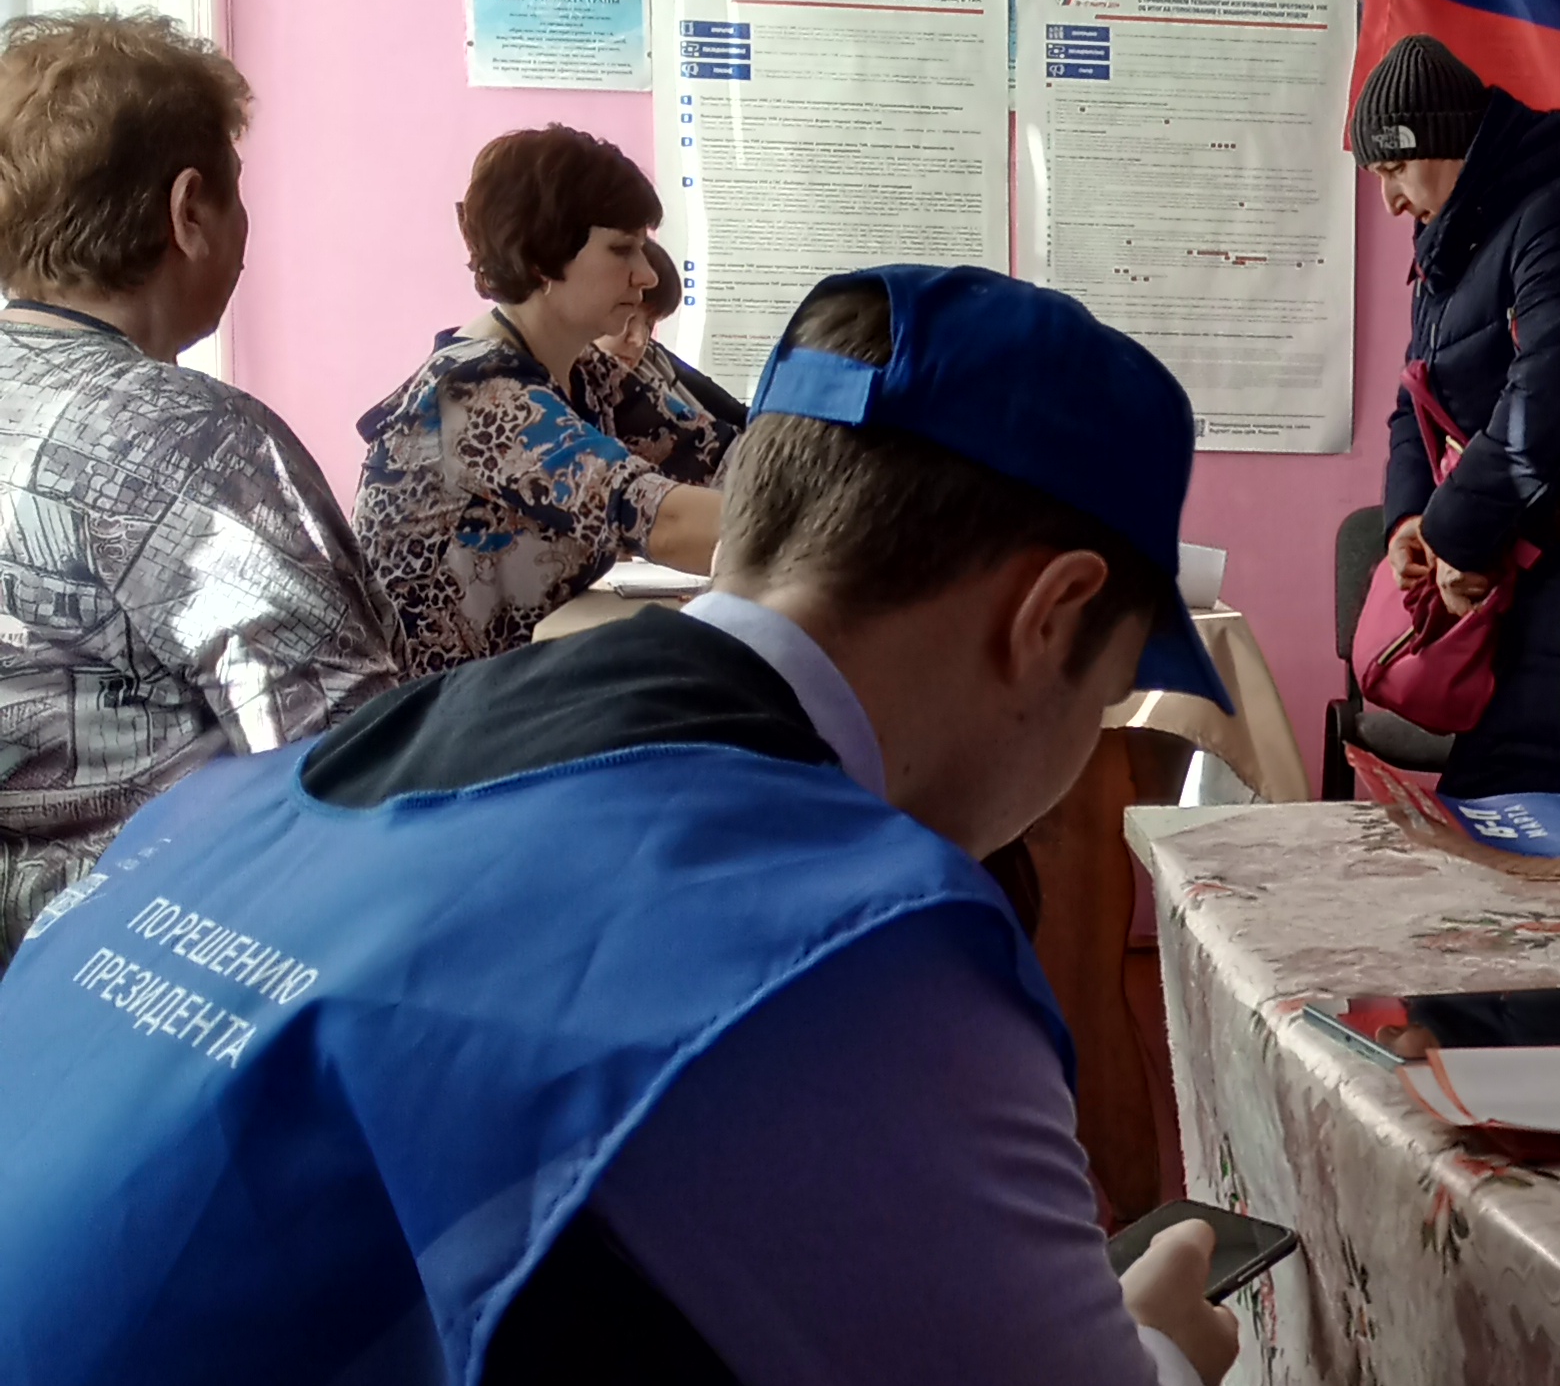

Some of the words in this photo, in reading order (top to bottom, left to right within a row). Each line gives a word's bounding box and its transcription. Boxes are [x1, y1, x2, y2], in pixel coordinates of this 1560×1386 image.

[73, 947, 258, 1070] ПРЕЗИДЕНТА
[126, 896, 183, 940] ПО
[159, 912, 320, 1005] РЕШЕНИЮ
